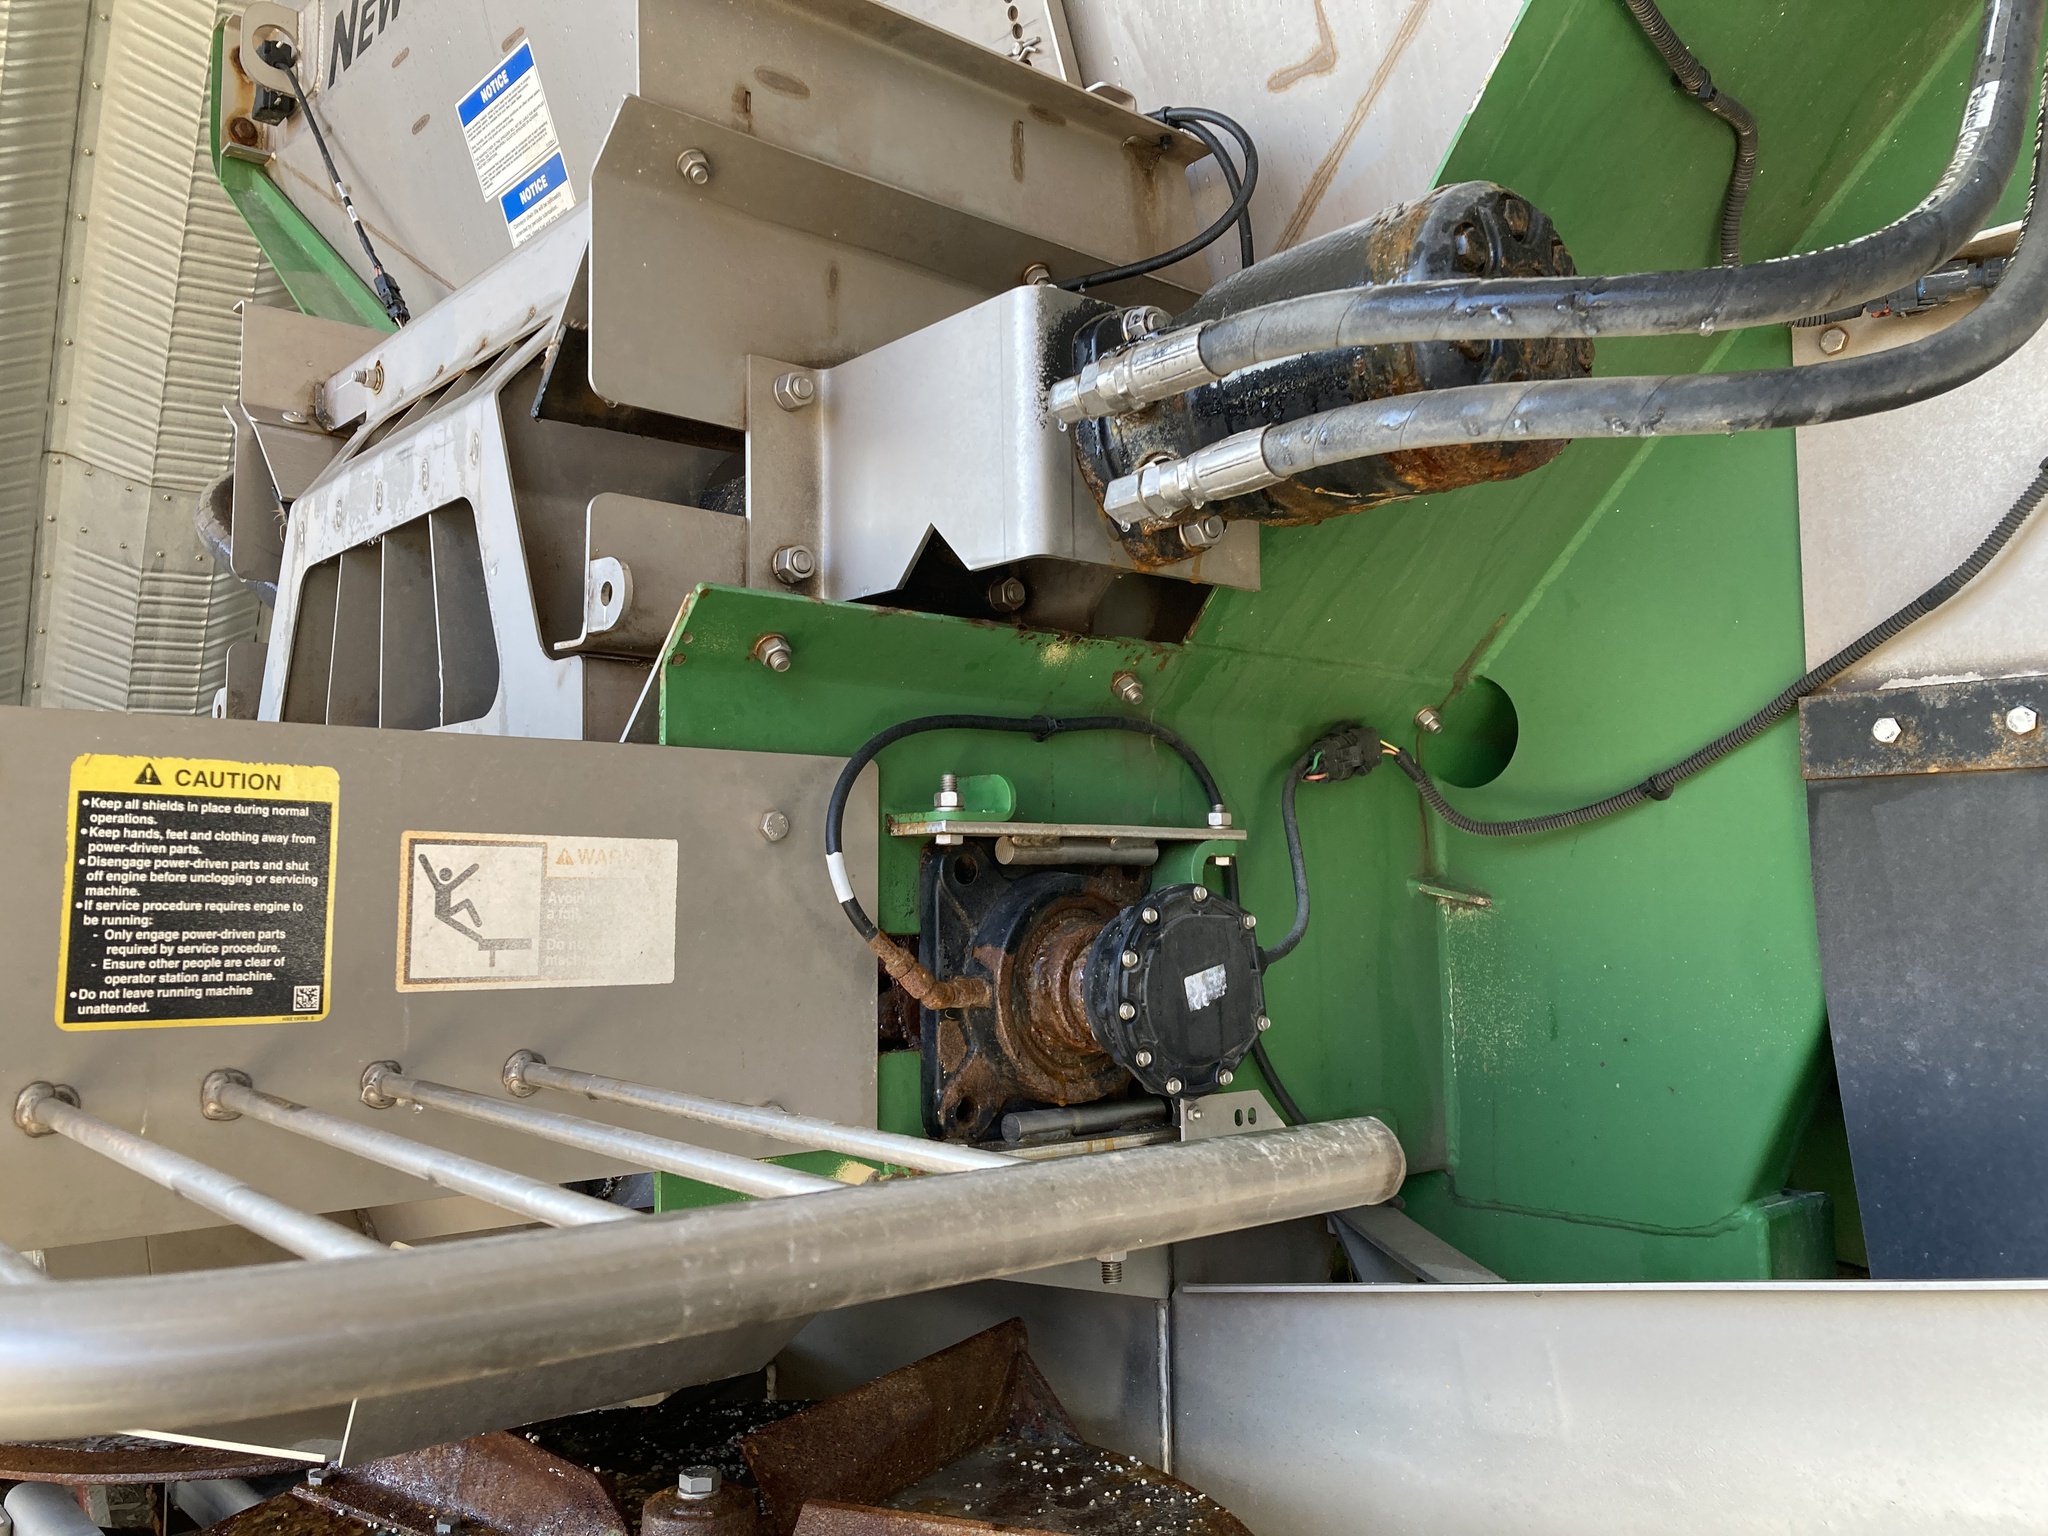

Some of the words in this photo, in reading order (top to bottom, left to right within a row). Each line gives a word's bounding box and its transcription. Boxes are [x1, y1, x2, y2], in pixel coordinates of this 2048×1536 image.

[480, 70, 509, 103] NOTICE
[519, 174, 548, 205] NOTICE
[175, 769, 281, 791] CAUTION
[91, 797, 122, 811] Keep
[125, 798, 139, 810] all
[142, 800, 184, 812] shields
[187, 801, 198, 812] in
[201, 803, 231, 814] place
[234, 804, 269, 817] during
[272, 807, 309, 816] normal
[90, 813, 158, 825] operations.
[89, 827, 120, 840] Keep
[123, 828, 164, 840] hands,
[166, 828, 188, 840] feet
[190, 830, 211, 841] and
[214, 831, 259, 844] clothing
[262, 834, 289, 845] away
[292, 834, 316, 844] from
[88, 842, 166, 854] power-driven
[169, 844, 203, 855] parts.
[87, 856, 151, 869] Disengage
[154, 858, 229, 870] power-driven
[231, 860, 260, 871] parts
[262, 860, 283, 870] and
[286, 861, 309, 870] shut
[86, 870, 105, 881] off
[106, 871, 147, 884] engine
[150, 872, 187, 882] before
[190, 872, 252, 886] unclogging
[269, 874, 318, 887] servicing
[85, 885, 141, 896] machine.
[84, 900, 93, 911] If
[96, 900, 140, 911] service
[143, 900, 202, 913] procedure
[205, 901, 251, 913] requires
[254, 902, 290, 913] engine
[293, 902, 303, 911] to
[83, 915, 99, 925] be
[102, 915, 153, 927] running:
[104, 929, 132, 942] Only
[136, 931, 179, 942] engage
[182, 929, 255, 941] power-driven
[258, 930, 286, 941] parts
[106, 944, 157, 957] required
[160, 944, 174, 956] by
[177, 943, 219, 954] service
[222, 943, 280, 955] procedure.
[103, 959, 145, 969] Ensure
[149, 958, 180, 969] other
[183, 957, 222, 970] people
[224, 959, 242, 968] are
[244, 957, 271, 967] clear
[274, 957, 285, 967] of
[104, 973, 157, 987] operator
[159, 972, 199, 983] station
[202, 972, 224, 982] and
[226, 971, 276, 981] machine.
[79, 989, 96, 1000] Do
[100, 988, 120, 999] not
[123, 988, 154, 998] leave
[157, 987, 203, 999] running
[206, 986, 253, 996] machine
[78, 1002, 150, 1014] unattended.
